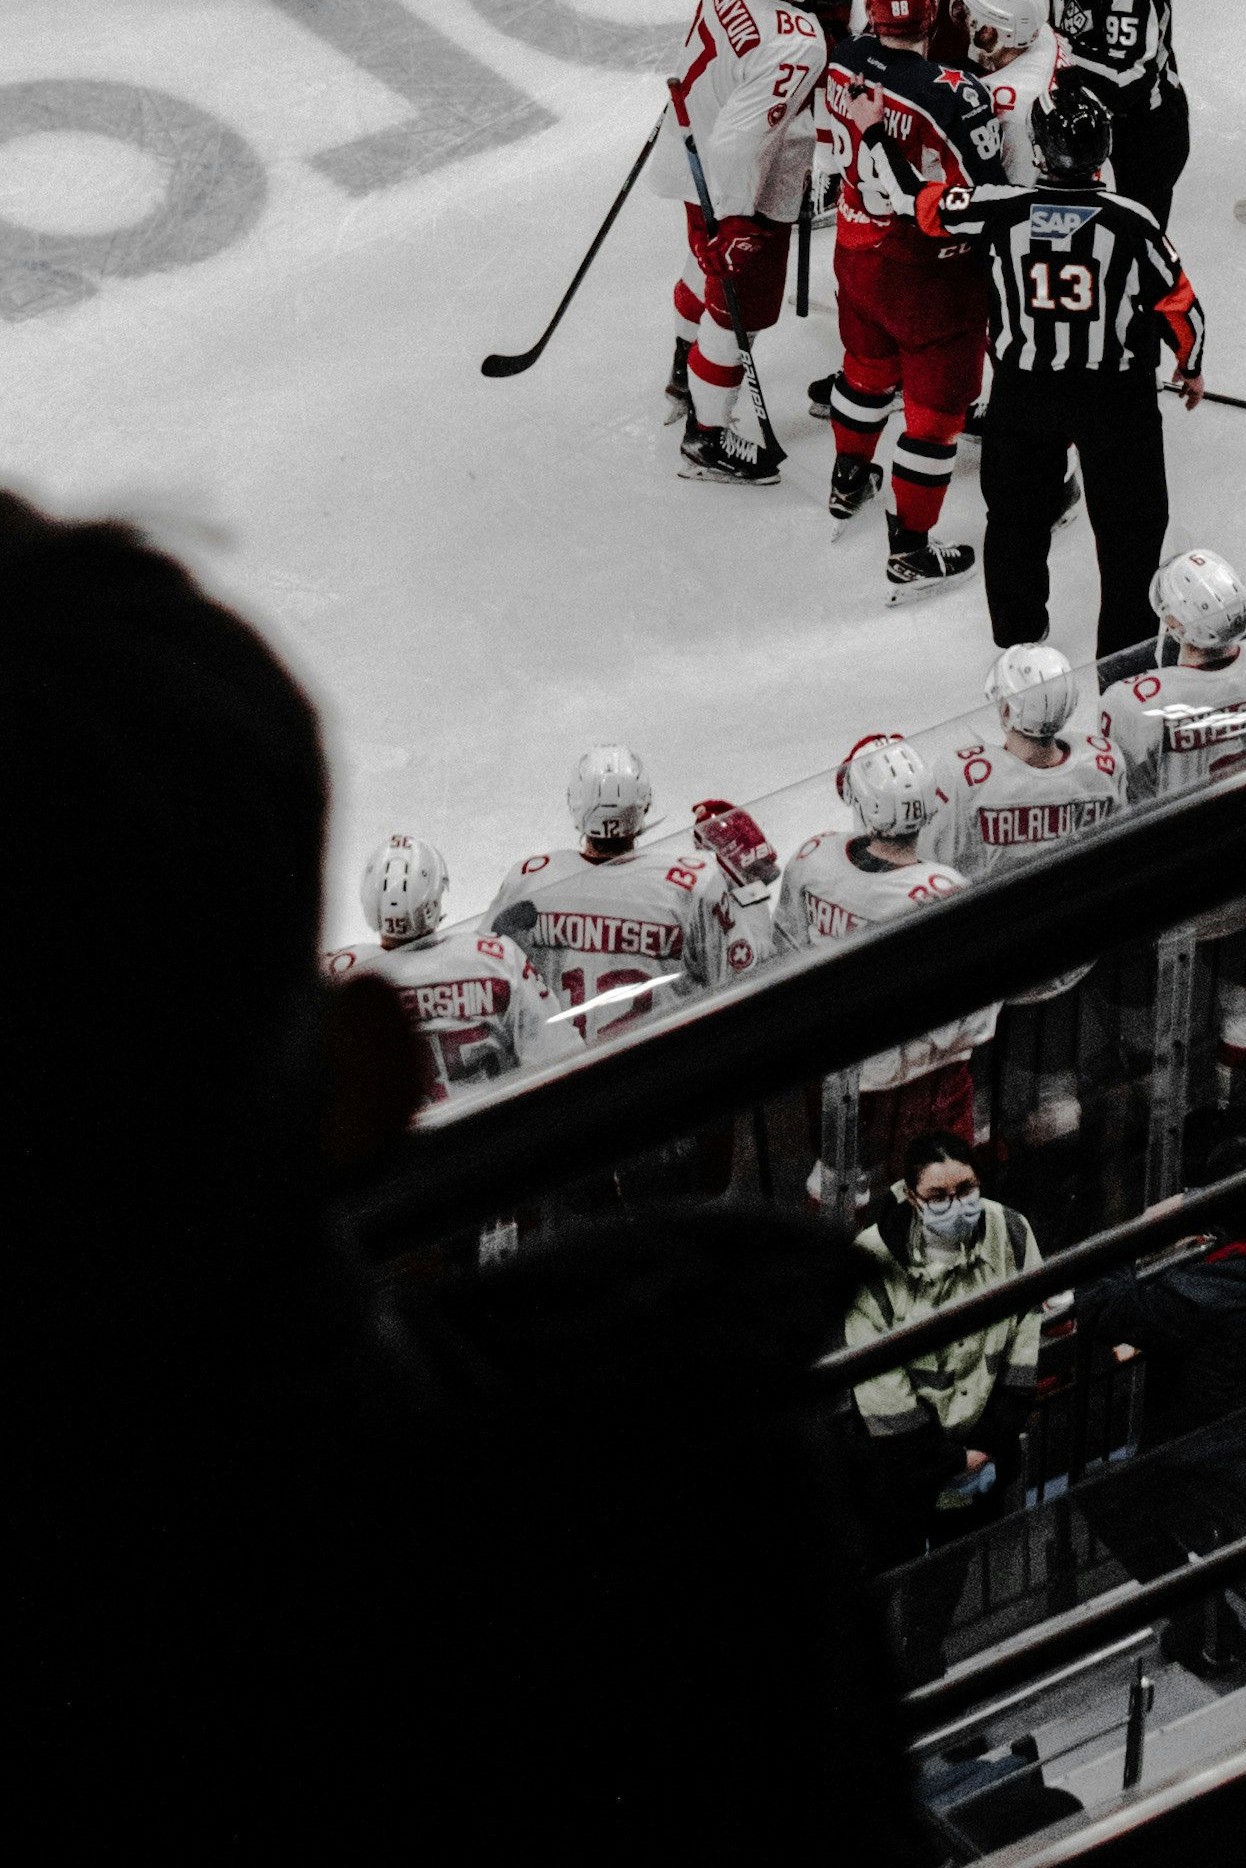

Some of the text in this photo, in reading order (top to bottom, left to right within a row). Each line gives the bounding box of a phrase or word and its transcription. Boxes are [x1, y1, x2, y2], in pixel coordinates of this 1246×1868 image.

[891, 0, 909, 18] 88
[1105, 14, 1140, 47] 95
[772, 62, 811, 99] 27
[1031, 210, 1082, 234] SAP
[1029, 261, 1094, 312] 13
[901, 800, 922, 820] 78
[601, 820, 620, 838] 12
